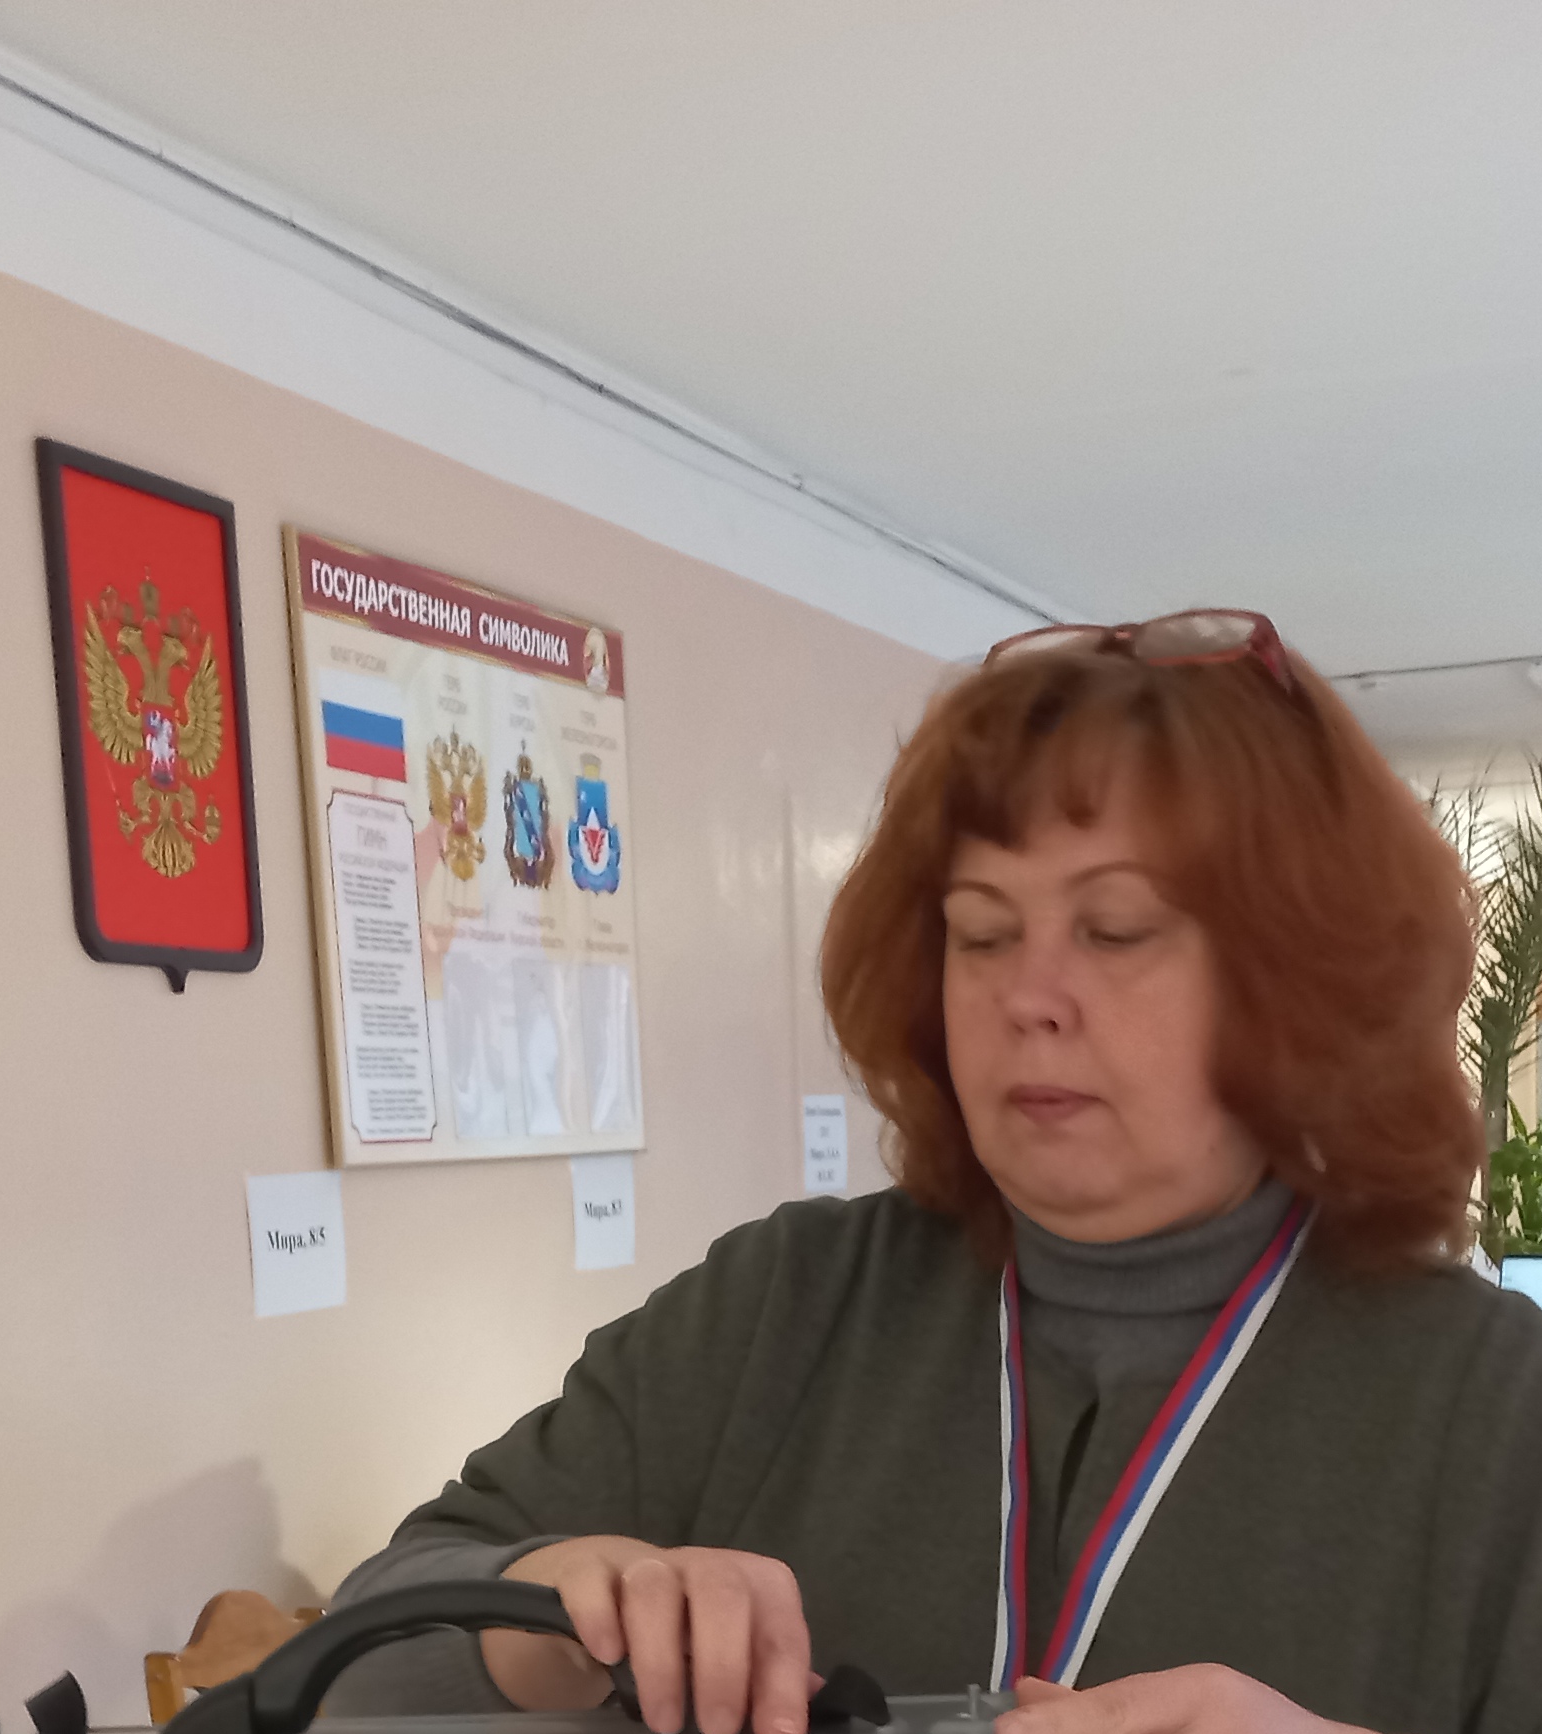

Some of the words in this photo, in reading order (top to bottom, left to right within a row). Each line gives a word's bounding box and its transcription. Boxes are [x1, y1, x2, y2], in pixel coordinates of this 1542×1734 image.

[311, 558, 471, 639] ГОСУДАРСТВЕННАЯ
[479, 613, 569, 666] СИМВОЛИКА
[267, 1230, 306, 1253] Мира,
